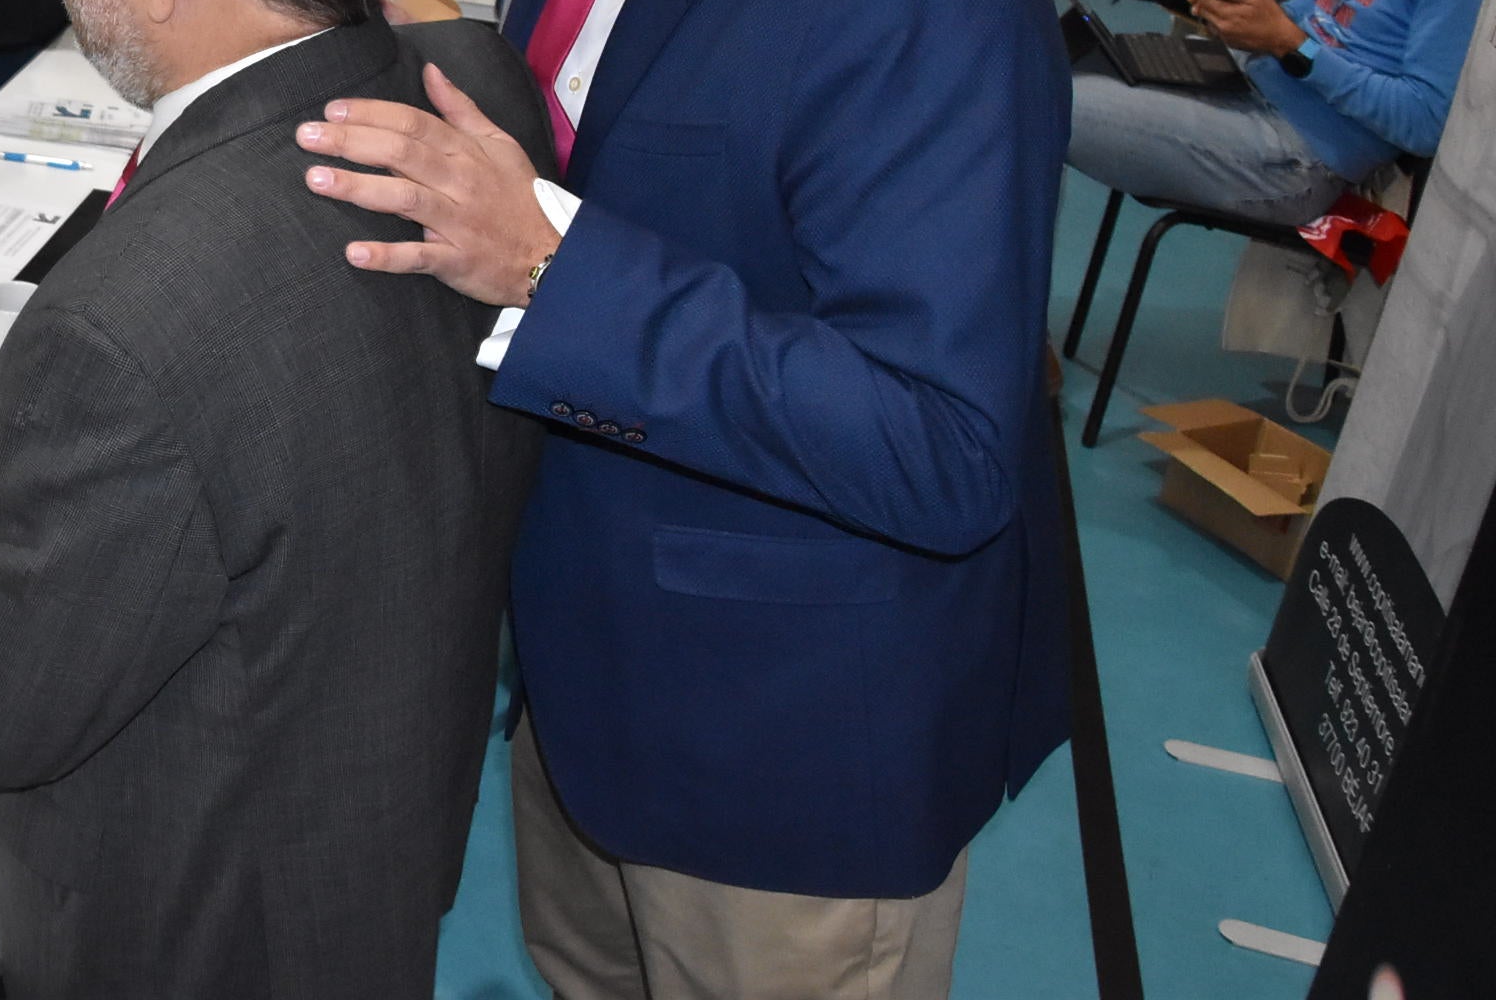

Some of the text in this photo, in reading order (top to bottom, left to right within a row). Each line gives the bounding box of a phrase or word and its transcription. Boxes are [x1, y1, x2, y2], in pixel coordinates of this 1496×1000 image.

[1309, 570, 1331, 617] Calle
[1326, 606, 1342, 639] 28
[1338, 633, 1351, 661] de
[1318, 713, 1346, 776] 37700
[1325, 660, 1344, 708] Telf.
[1356, 737, 1371, 769] 40
[1367, 760, 1384, 795] 31
